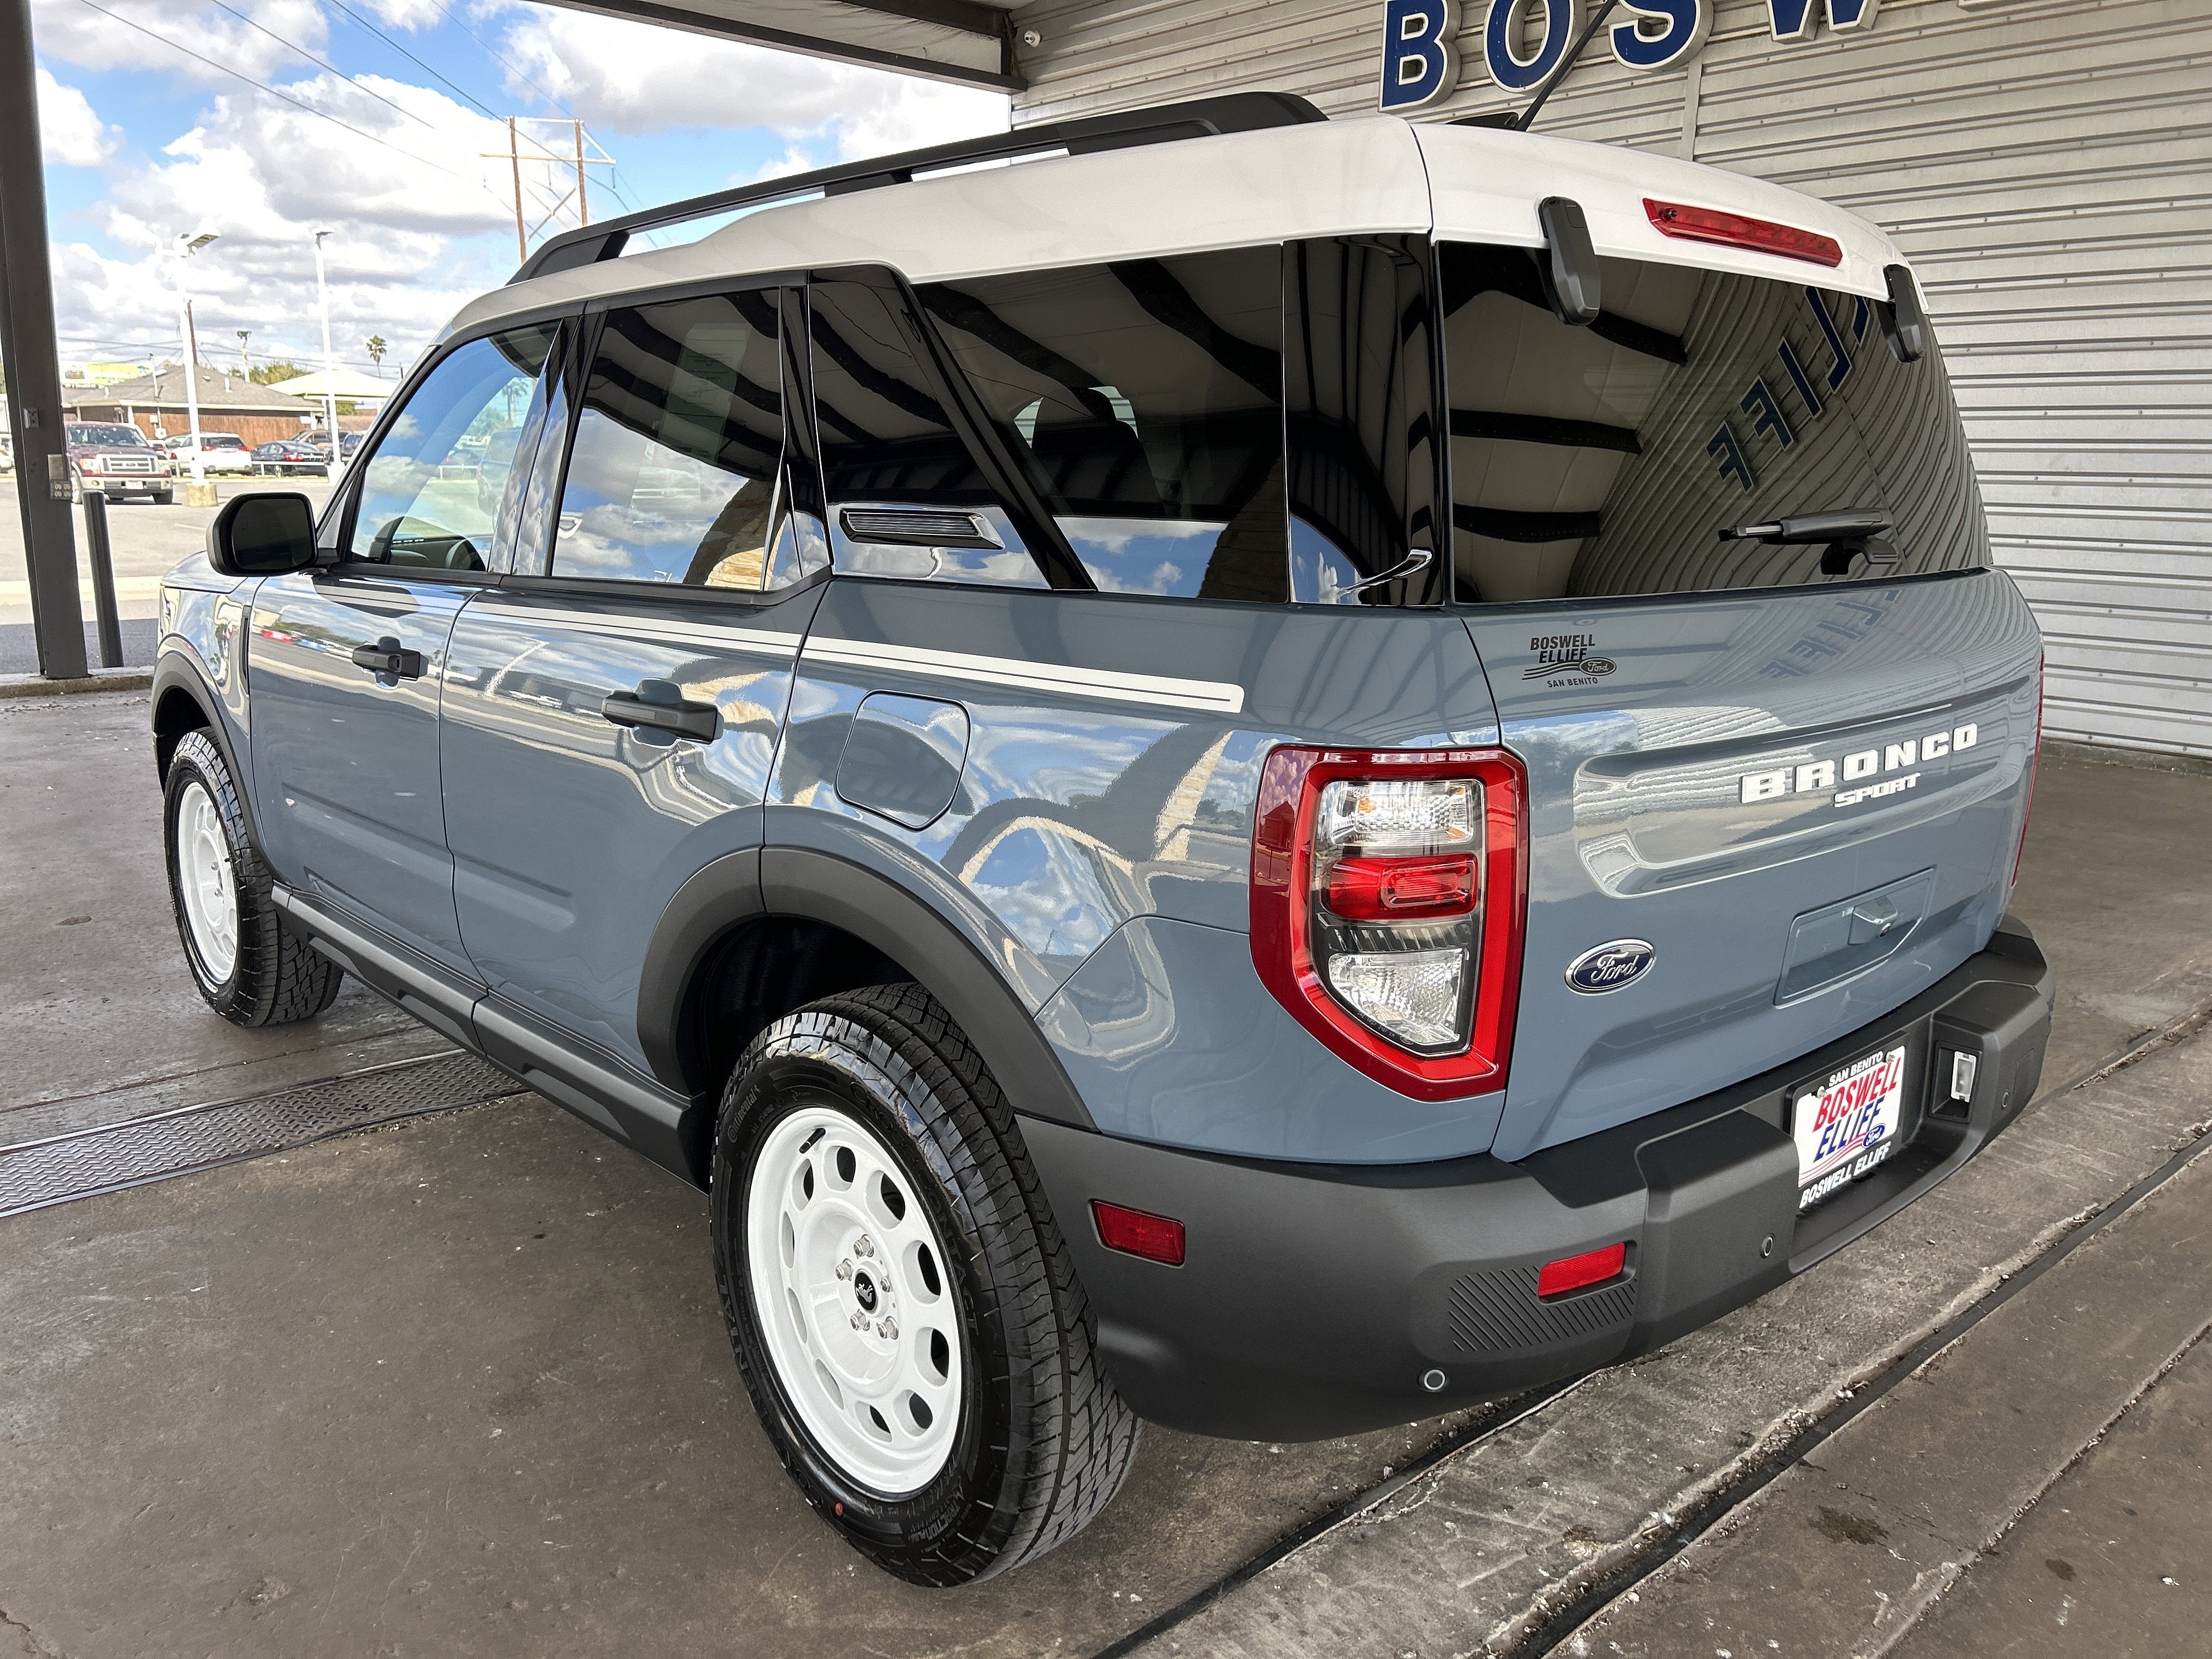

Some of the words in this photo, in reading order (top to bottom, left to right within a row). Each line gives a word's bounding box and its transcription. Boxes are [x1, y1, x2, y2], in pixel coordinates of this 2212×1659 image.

[1530, 634, 1595, 650] BOSWELL
[1547, 679, 1565, 687] SAN
[1568, 677, 1598, 686] BENITO
[1587, 661, 1610, 672] Ford
[1739, 723, 1977, 803] BRONCO
[1834, 772, 1921, 808] SPORT
[1590, 951, 1640, 984] Ford
[1829, 1068, 1849, 1087] SAN
[1850, 1051, 1883, 1075] BENITO
[1812, 1057, 1901, 1133] BOSWELL
[727, 1087, 758, 1143] Continental
[1813, 1095, 1885, 1163] ELLIFF
[1799, 1163, 1852, 1209] BOSWELL
[1853, 1141, 1892, 1177] ELLIFF
